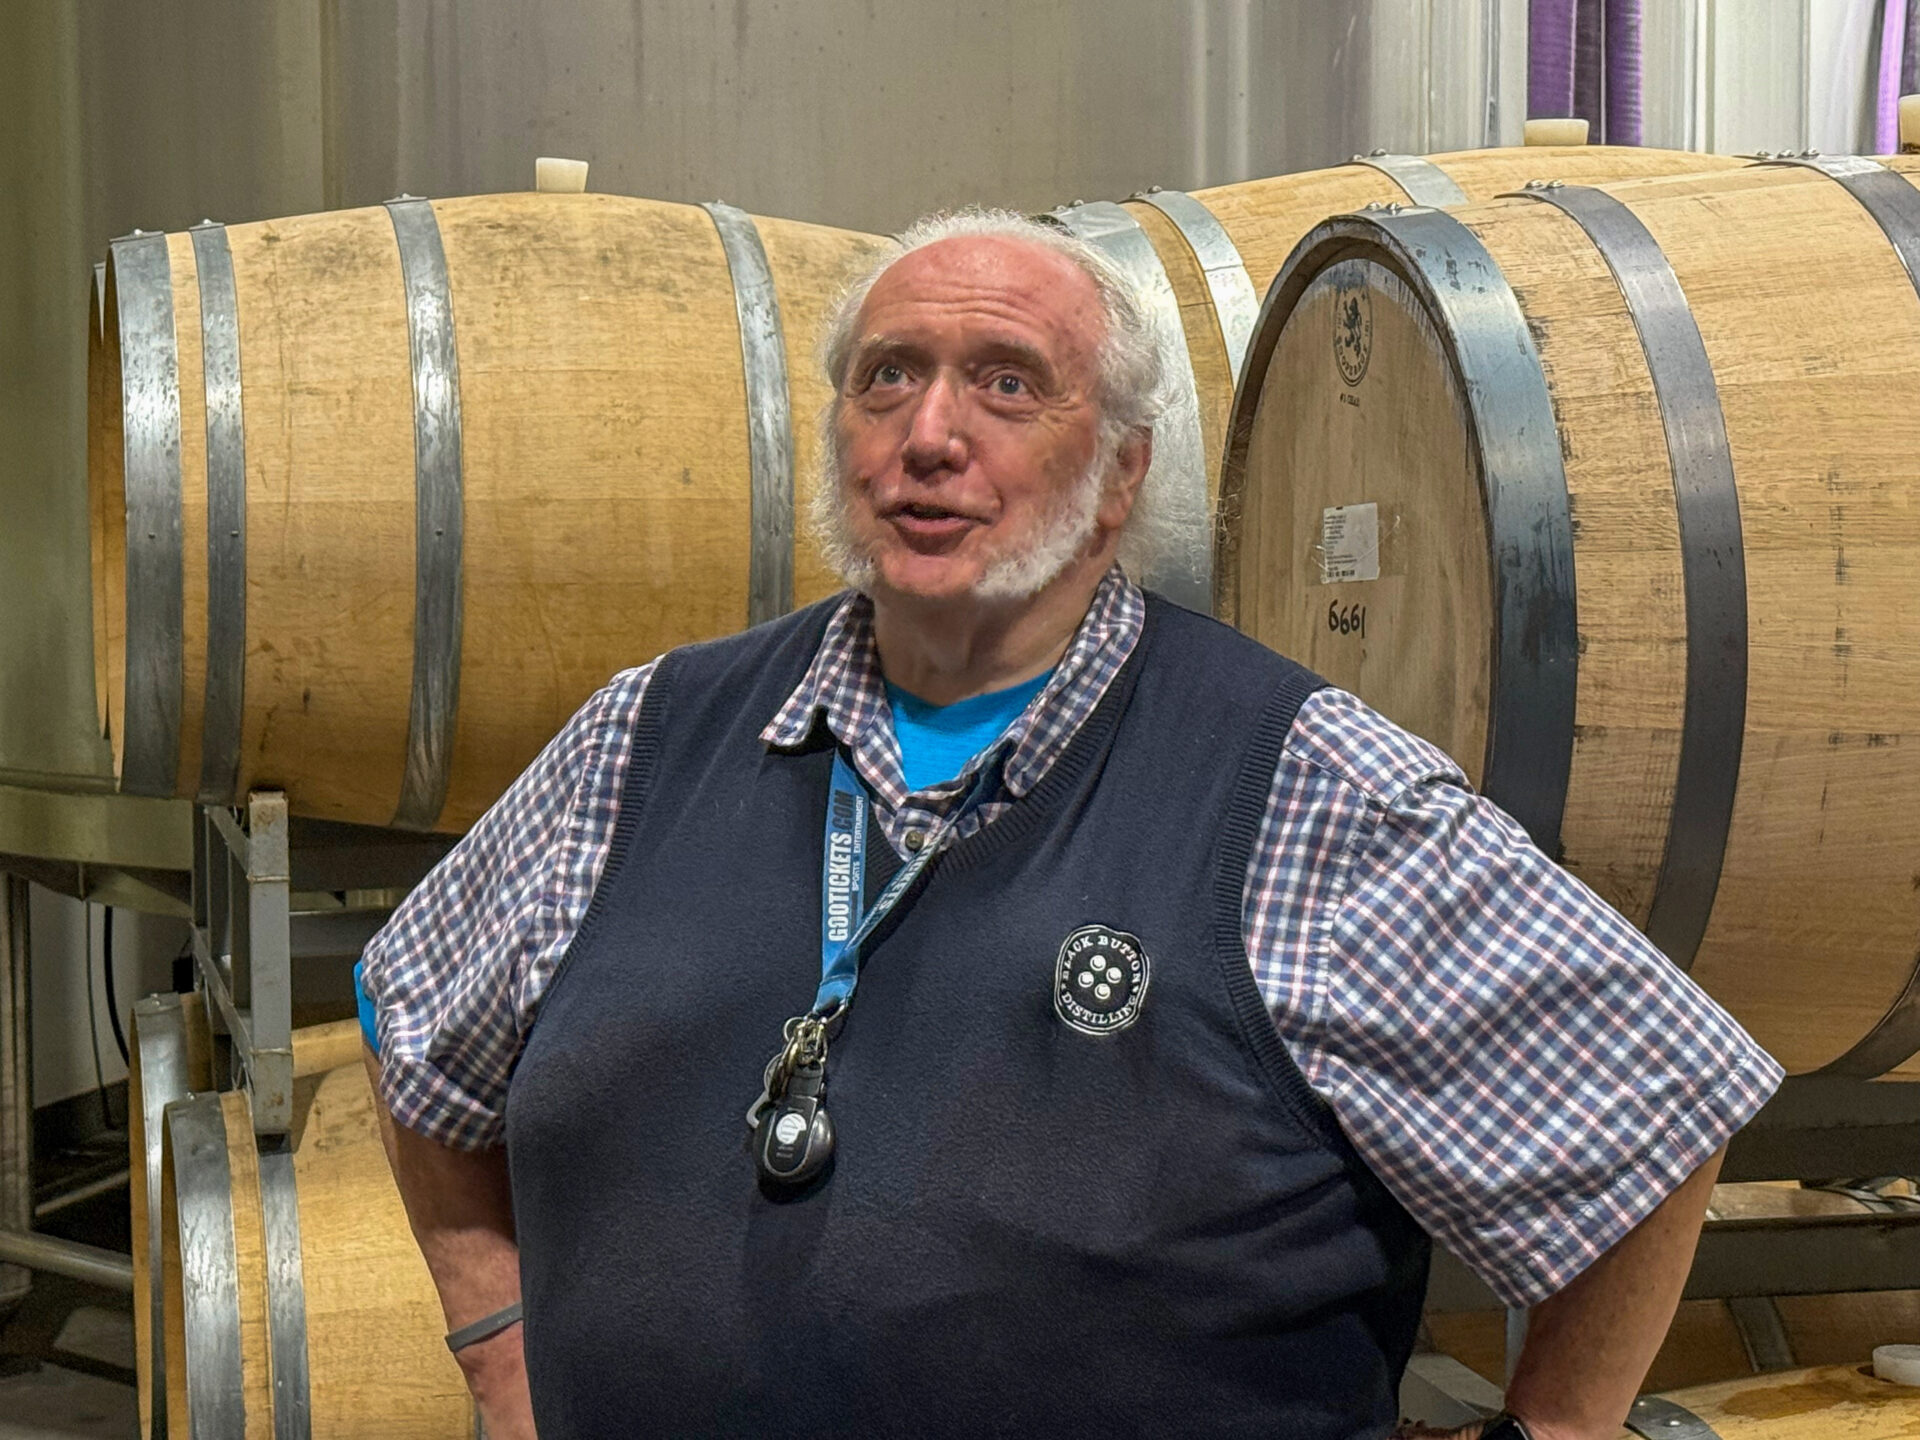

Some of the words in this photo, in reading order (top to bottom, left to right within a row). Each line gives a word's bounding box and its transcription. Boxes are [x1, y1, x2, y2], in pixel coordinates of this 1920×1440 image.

[1328, 598, 1366, 639] 6661
[852, 862, 861, 891] SPORTS
[1062, 936, 1093, 980] BLACK
[1097, 935, 1141, 984] BUTTON
[1061, 991, 1137, 1025] DISTILLING
